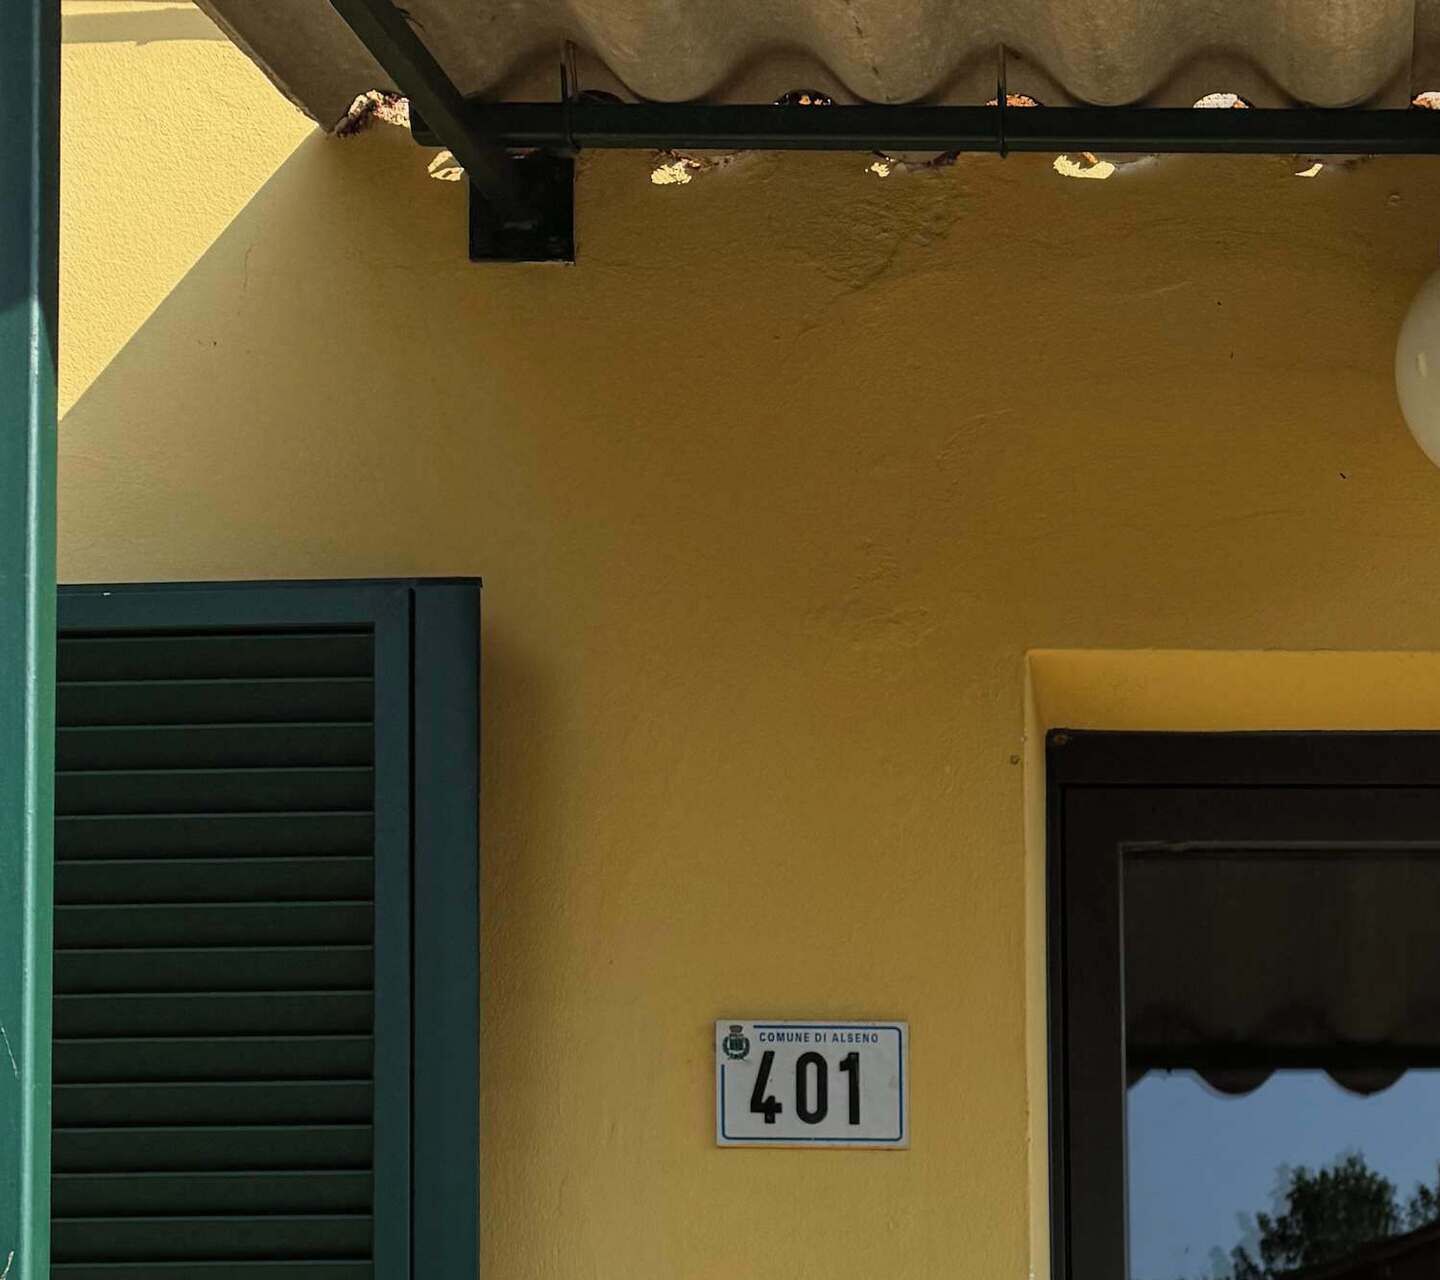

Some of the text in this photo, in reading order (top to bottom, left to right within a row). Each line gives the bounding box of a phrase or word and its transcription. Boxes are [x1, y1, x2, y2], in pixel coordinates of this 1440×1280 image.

[759, 1032, 879, 1044] COMUNE DI ALSENO
[750, 1050, 860, 1125] 401
